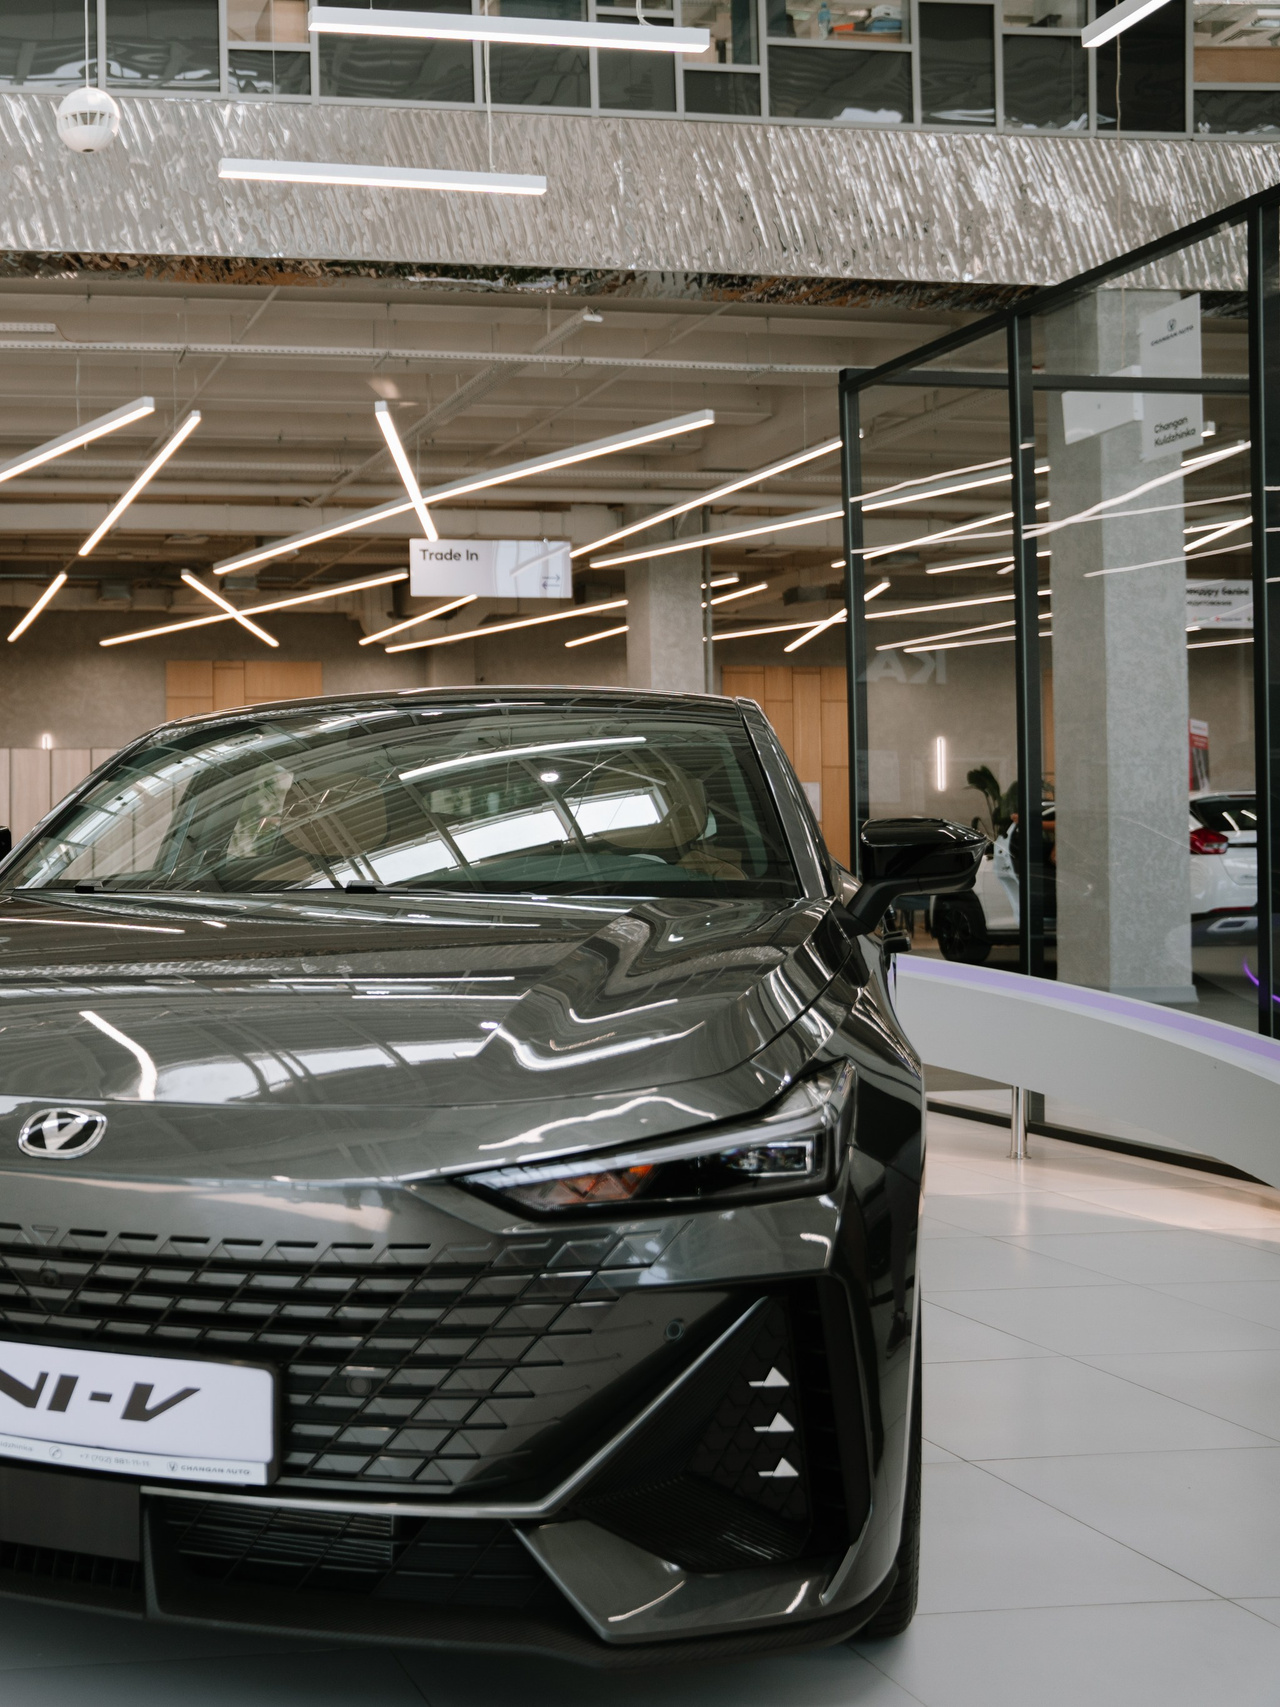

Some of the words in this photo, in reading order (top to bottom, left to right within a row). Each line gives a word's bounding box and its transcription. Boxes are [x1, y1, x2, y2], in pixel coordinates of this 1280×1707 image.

[1153, 416, 1188, 434] Changan
[1154, 428, 1197, 447] Kuldzhinka
[420, 549, 462, 561] Trade
[466, 549, 479, 561] In
[180, 1464, 224, 1474] CHANGAN
[224, 1467, 251, 1476] AUTO
